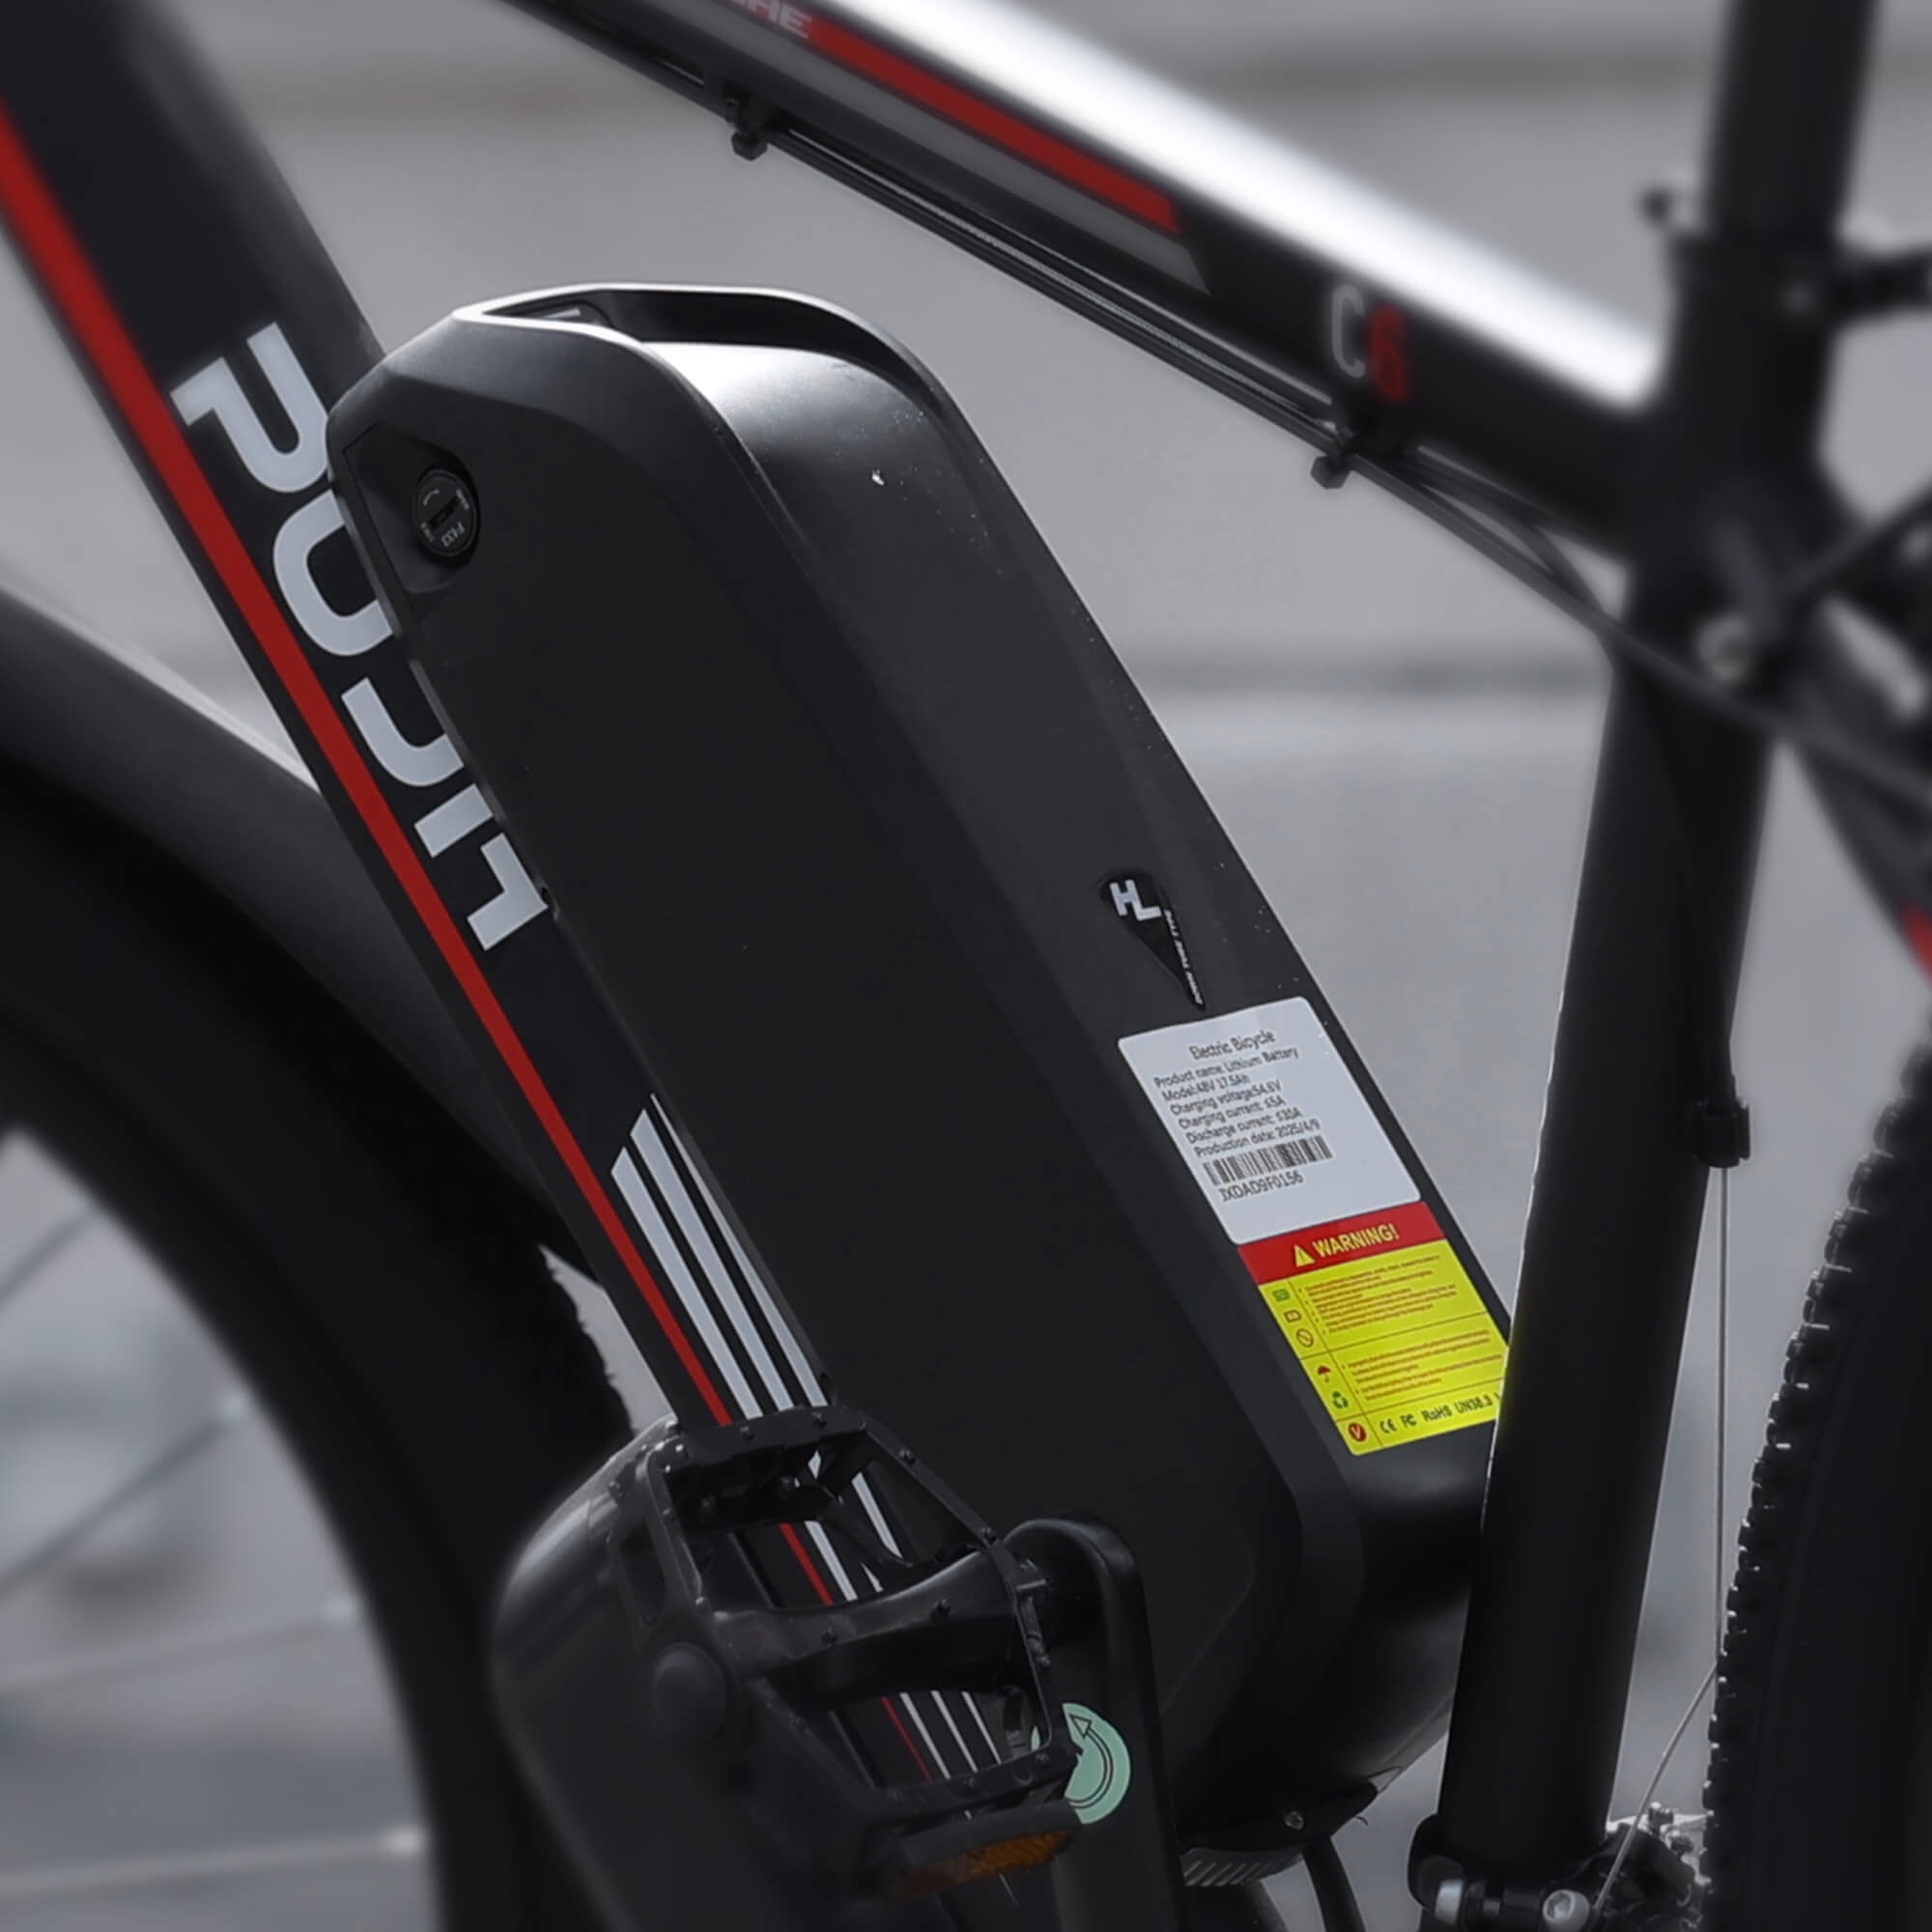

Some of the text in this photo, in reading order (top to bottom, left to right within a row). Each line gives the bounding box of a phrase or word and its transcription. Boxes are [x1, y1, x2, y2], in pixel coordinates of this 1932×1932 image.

[1188, 1030, 1275, 1060] Electric Bicycle
[1153, 1070, 1194, 1087] Product
[1263, 1047, 1298, 1063] Battery
[1171, 1097, 1217, 1115] Charging
[1179, 1112, 1226, 1129] Charging
[1185, 1124, 1236, 1144] Discharge
[1194, 1137, 1250, 1157] Production
[1313, 1223, 1399, 1258] WARNING!
[1423, 1405, 1453, 1422] RoHS
